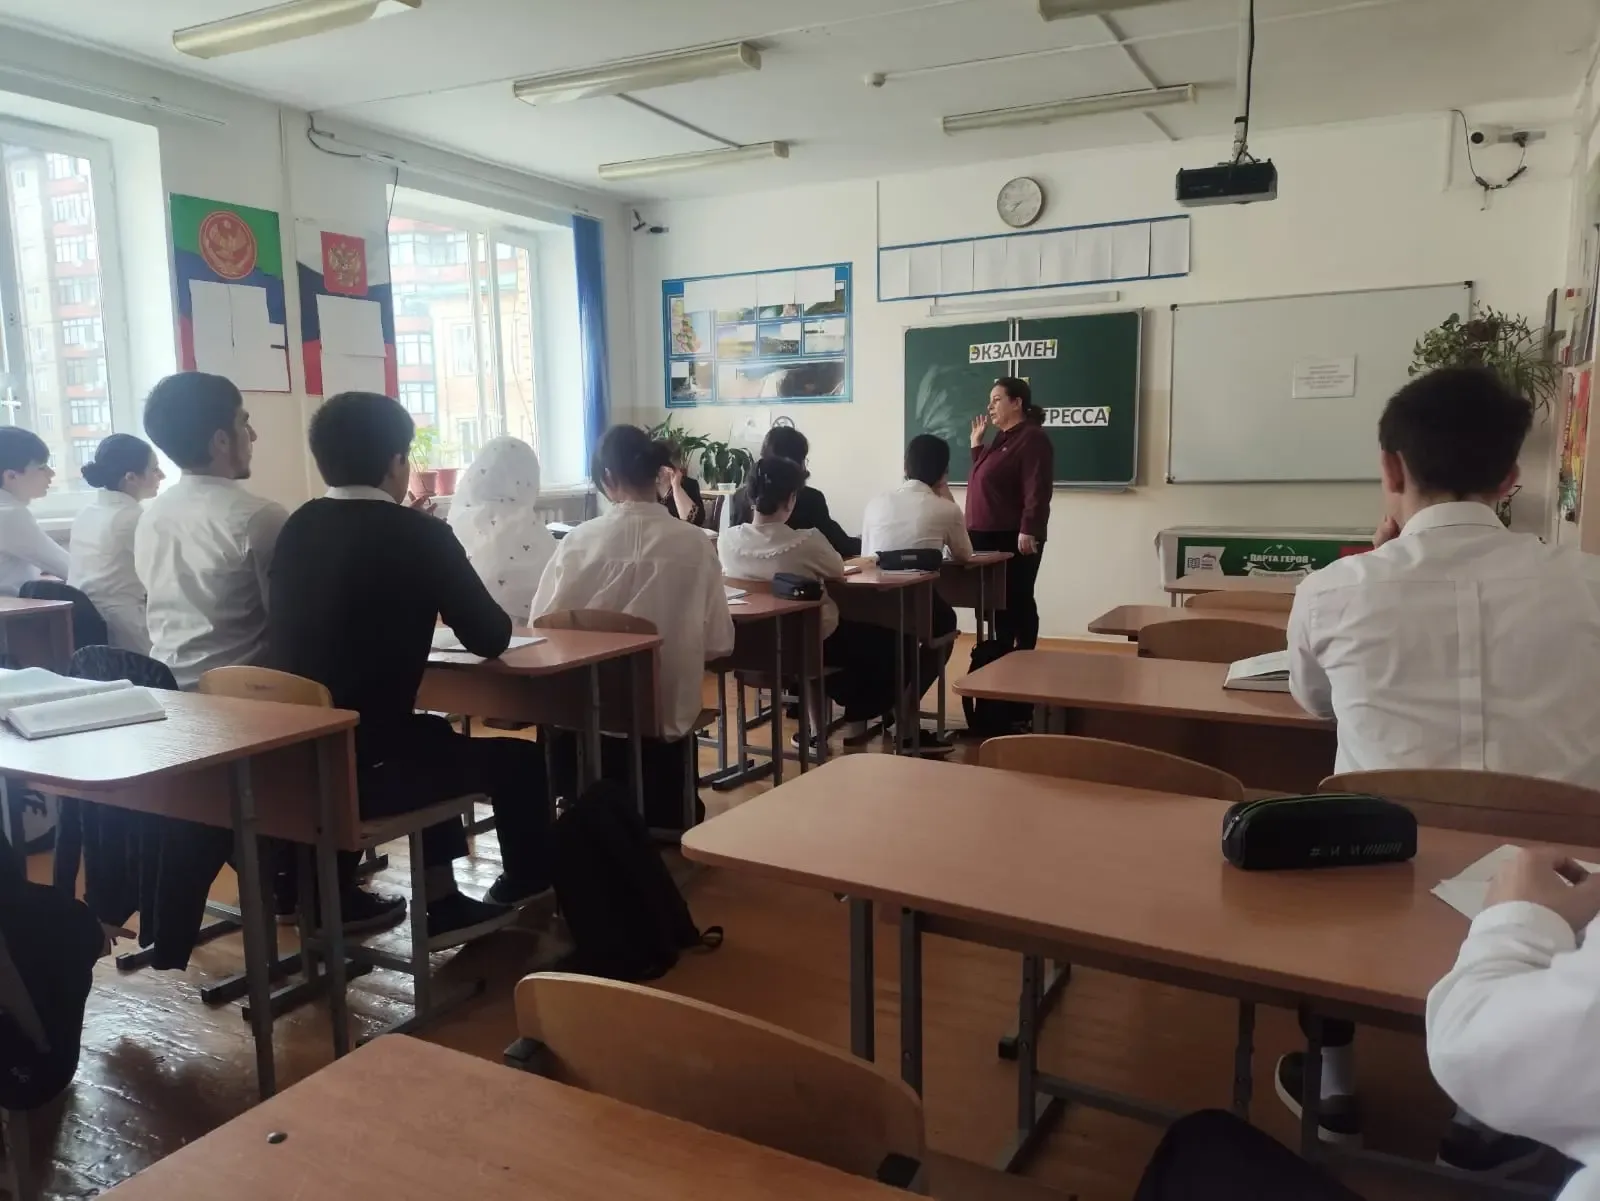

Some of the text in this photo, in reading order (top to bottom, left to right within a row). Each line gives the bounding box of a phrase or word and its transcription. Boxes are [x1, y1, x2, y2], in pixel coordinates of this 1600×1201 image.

[970, 341, 1055, 361] ЭКЗАМЕН
[1250, 553, 1309, 564] ПАРТА ГЕРОЯ
